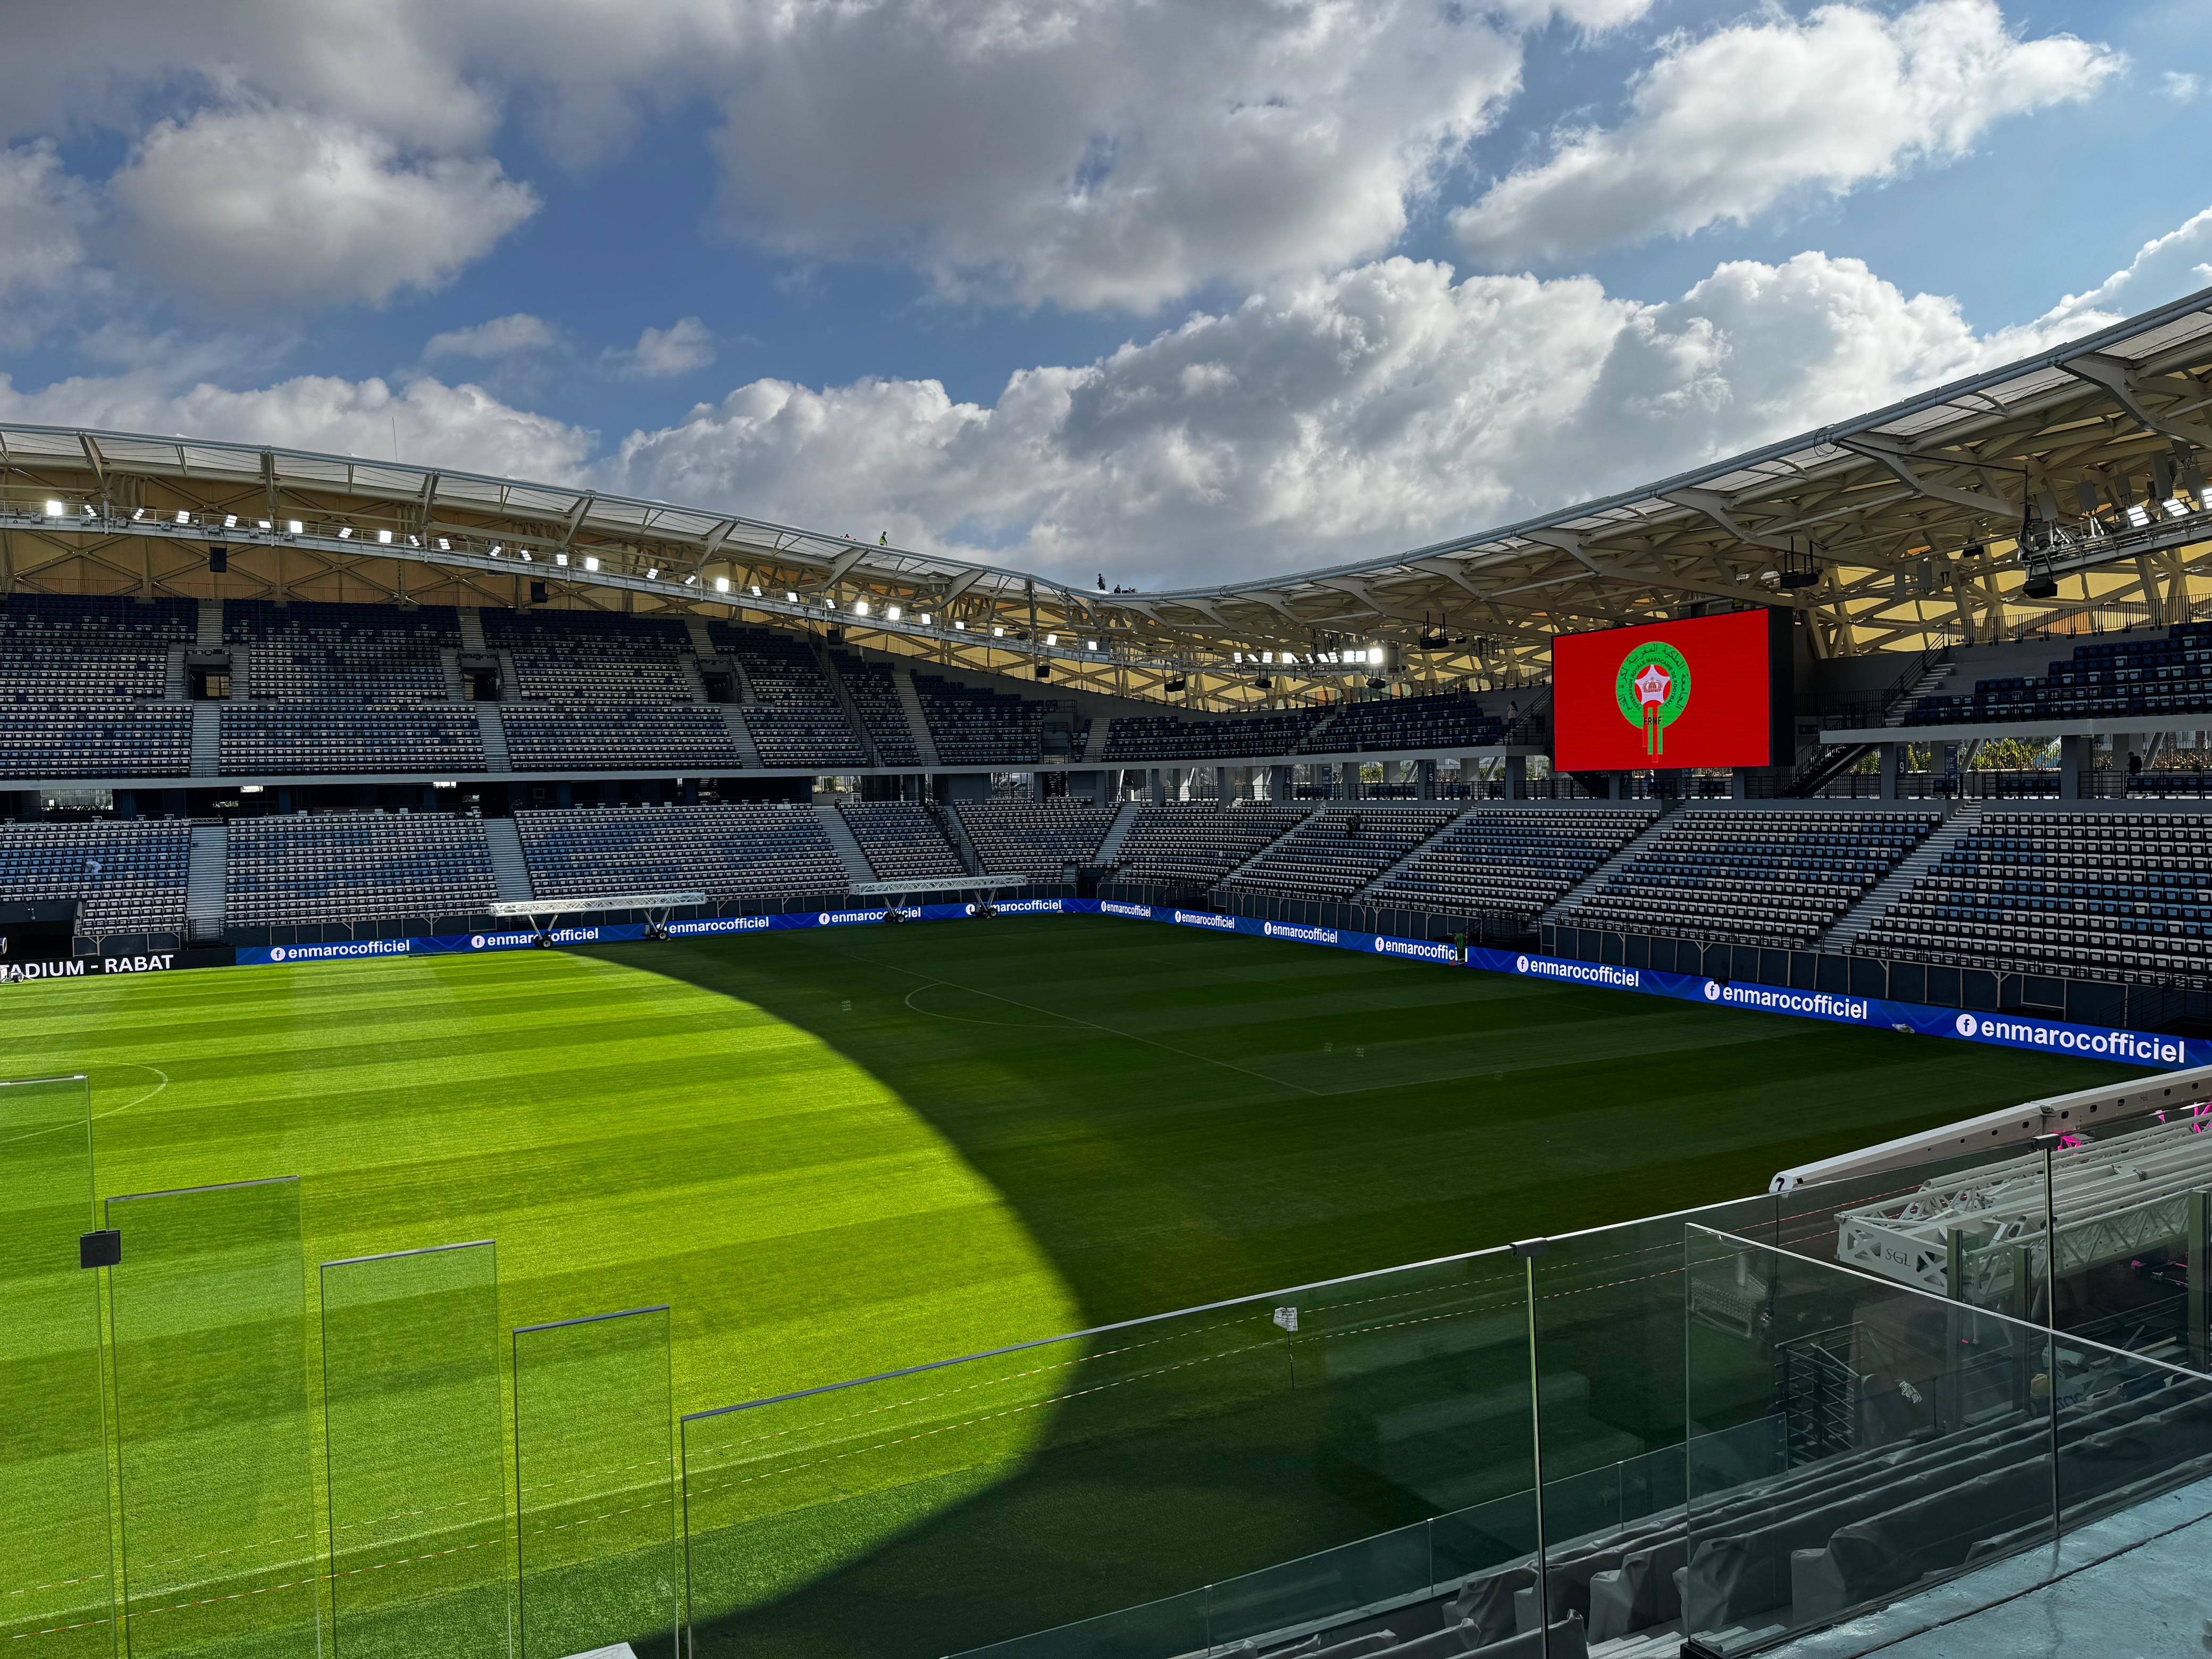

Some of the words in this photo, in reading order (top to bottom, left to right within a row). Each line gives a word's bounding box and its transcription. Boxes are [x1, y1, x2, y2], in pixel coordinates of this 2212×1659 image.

[1630, 660, 1646, 678] ROYALE
[1646, 657, 1673, 671] MAROCAINE
[1628, 679, 1641, 710] FEDERATION
[1664, 680, 1677, 707] FOOTBALL
[1644, 716, 1662, 725] FRMF
[1899, 761, 1904, 773] 9
[1429, 773, 1434, 782] 5
[832, 907, 921, 923] enmarocciel
[979, 899, 1062, 913] marocofficiel
[1107, 903, 1151, 917] enmarocofficiel
[669, 916, 769, 934] enmarocofficiel
[1182, 914, 1235, 929] enmarocofficiel
[487, 927, 599, 946] enmarofficiel
[1272, 925, 1338, 943] enmarocofficiel
[288, 939, 410, 959] enmarocofficiel
[1385, 941, 1468, 962] enmarocofficil
[105, 954, 174, 973] RABAT
[1530, 960, 1639, 987] enmarocofficiel
[1723, 986, 1867, 1019] enmarocofficiel
[1981, 1021, 2184, 1063] enmarocofficiel
